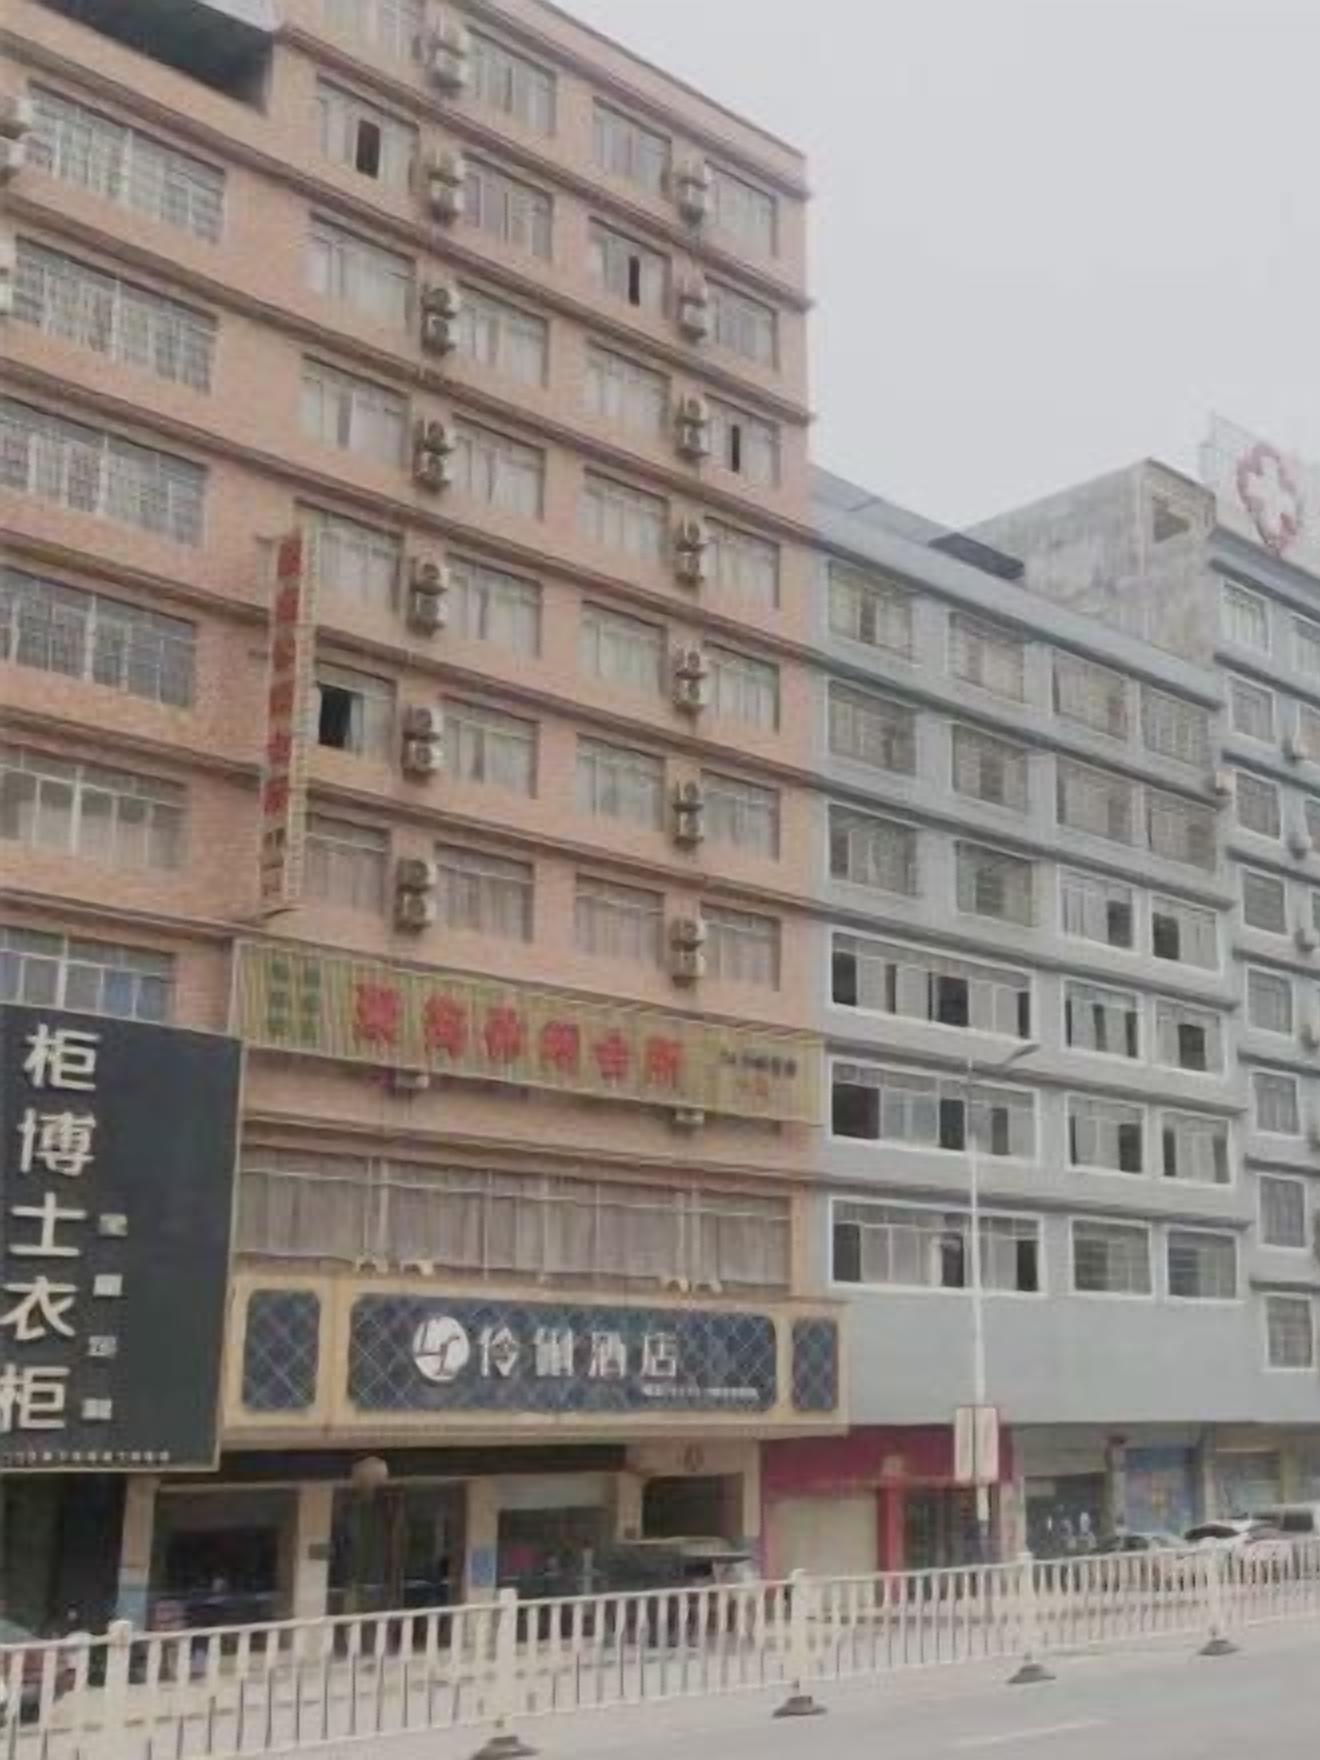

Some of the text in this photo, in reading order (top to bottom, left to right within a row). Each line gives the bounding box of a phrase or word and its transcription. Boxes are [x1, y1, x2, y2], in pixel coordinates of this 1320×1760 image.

[0, 1023, 99, 1433] 柜博士衣柜
